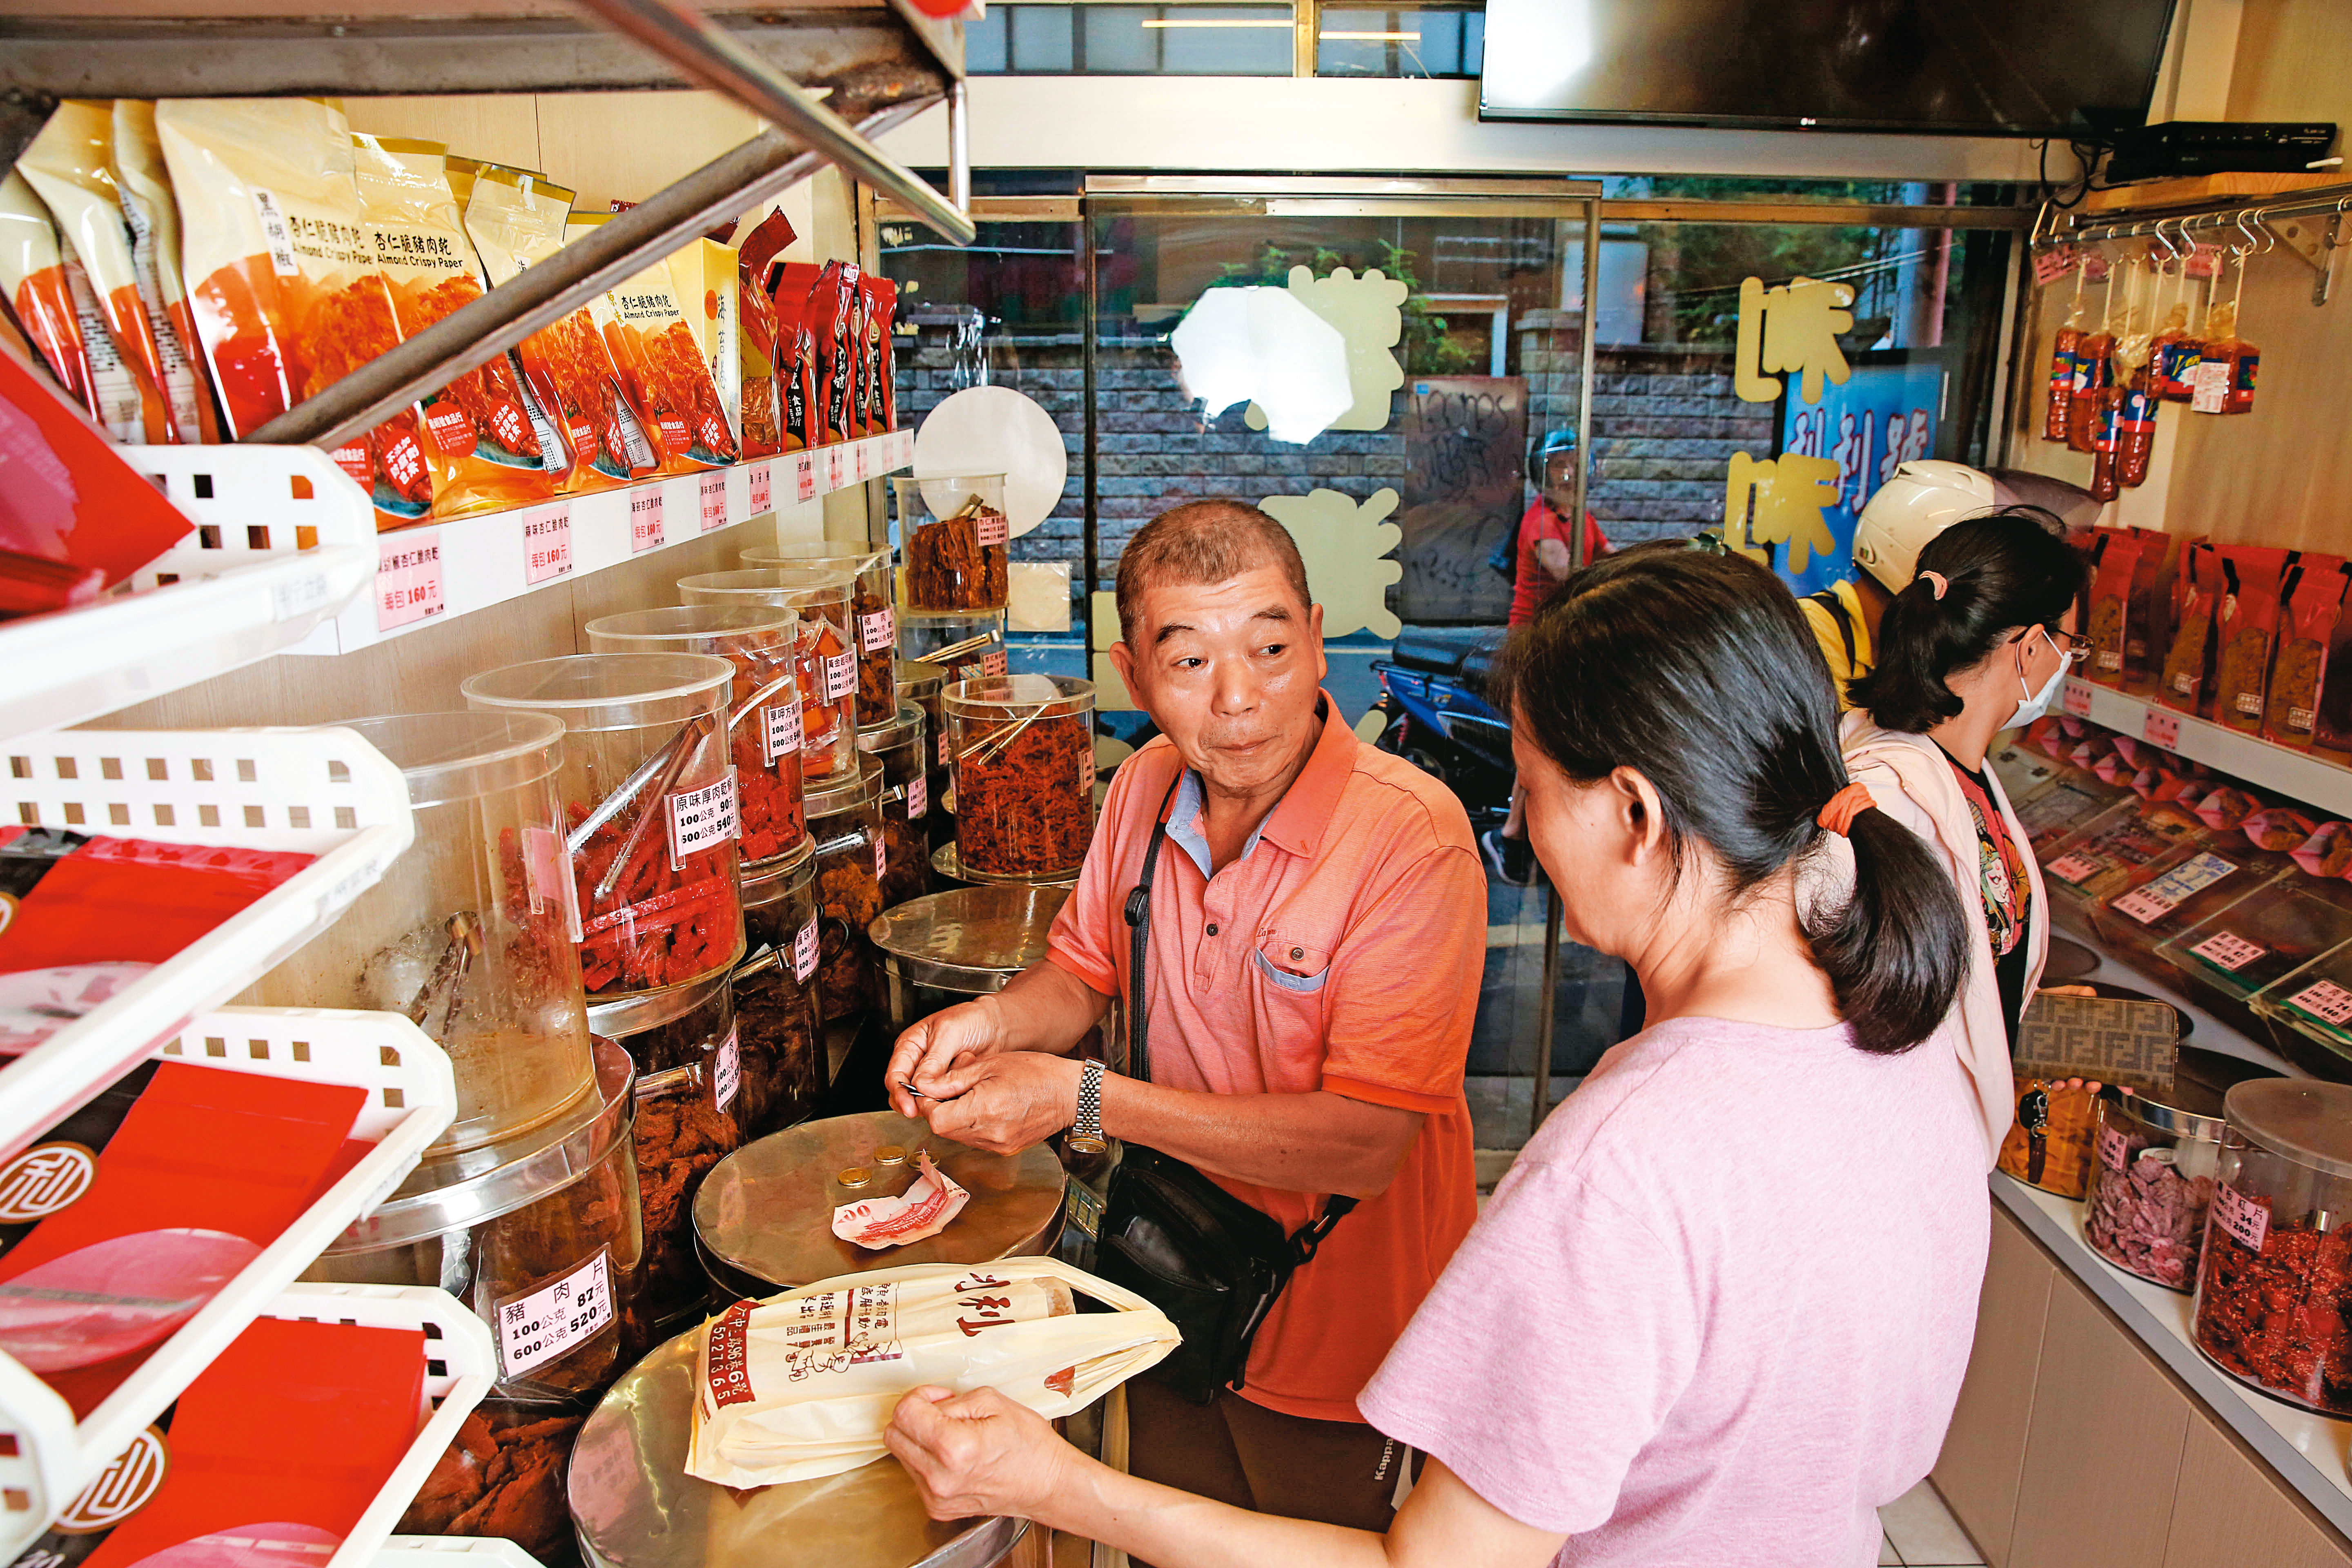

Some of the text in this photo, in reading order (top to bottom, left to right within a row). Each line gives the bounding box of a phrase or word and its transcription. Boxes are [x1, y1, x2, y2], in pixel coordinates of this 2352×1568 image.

[374, 231, 452, 256] 杏仁脆豬肉乾
[353, 250, 373, 265] Pape
[377, 254, 463, 269] Almond Crispy Paper
[621, 294, 672, 310] 杏仁脆豬肉乾
[646, 310, 664, 320] Crispy
[492, 405, 510, 426] 不添加
[498, 410, 519, 439] 防腐劑
[507, 424, 522, 443] 色素
[829, 654, 852, 668] 黃金起司
[772, 721, 793, 734] 100公克
[773, 735, 793, 748] 600公克
[681, 808, 715, 827] 100公克
[506, 1257, 603, 1325] 豬肉片
[513, 1280, 604, 1340] 100公克 87元
[514, 1299, 607, 1360] 600公克 520元
[786, 1322, 835, 1336] 最佳禮品
[1374, 1438, 1394, 1480] Kappa
